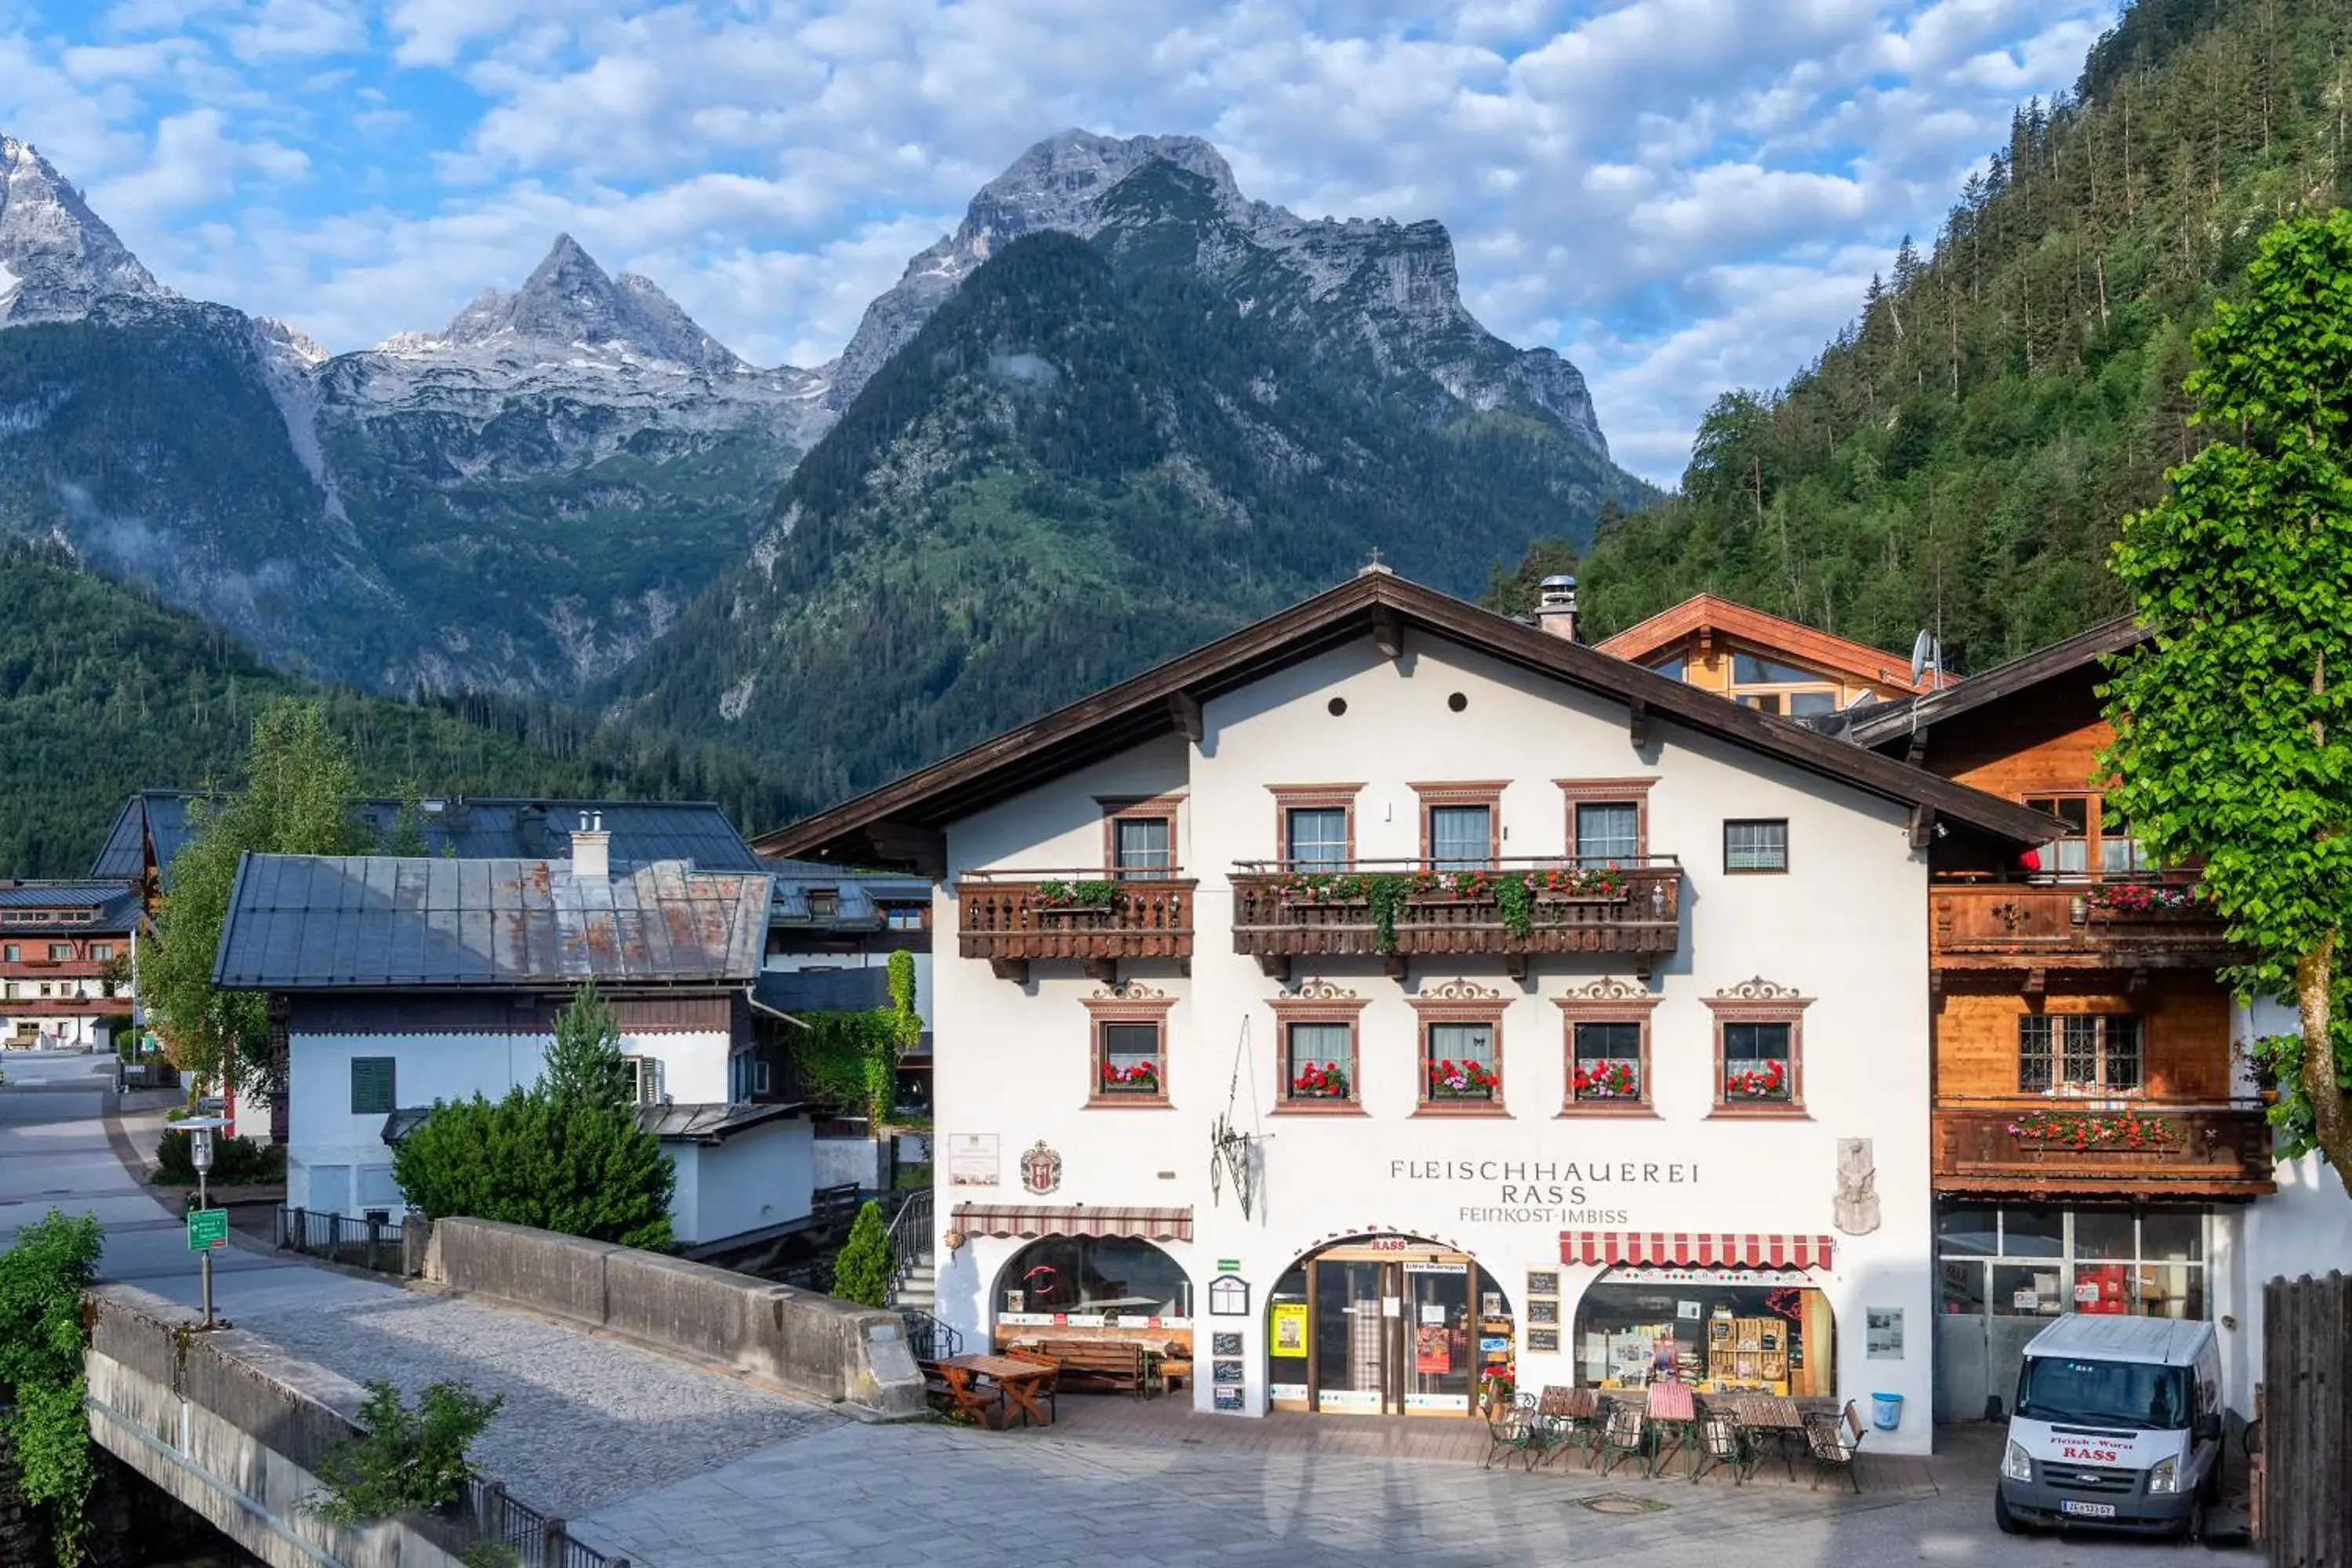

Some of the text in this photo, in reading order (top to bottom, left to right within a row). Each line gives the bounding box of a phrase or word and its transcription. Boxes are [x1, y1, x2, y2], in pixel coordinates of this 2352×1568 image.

[1390, 1160, 1699, 1183] FLEISCHHAUEREI
[1501, 1184, 1587, 1205] RASS
[2050, 1437, 2089, 1446] Fleisch
[2099, 1439, 2133, 1450] Wurst
[2063, 1446, 2117, 1462] RASS
